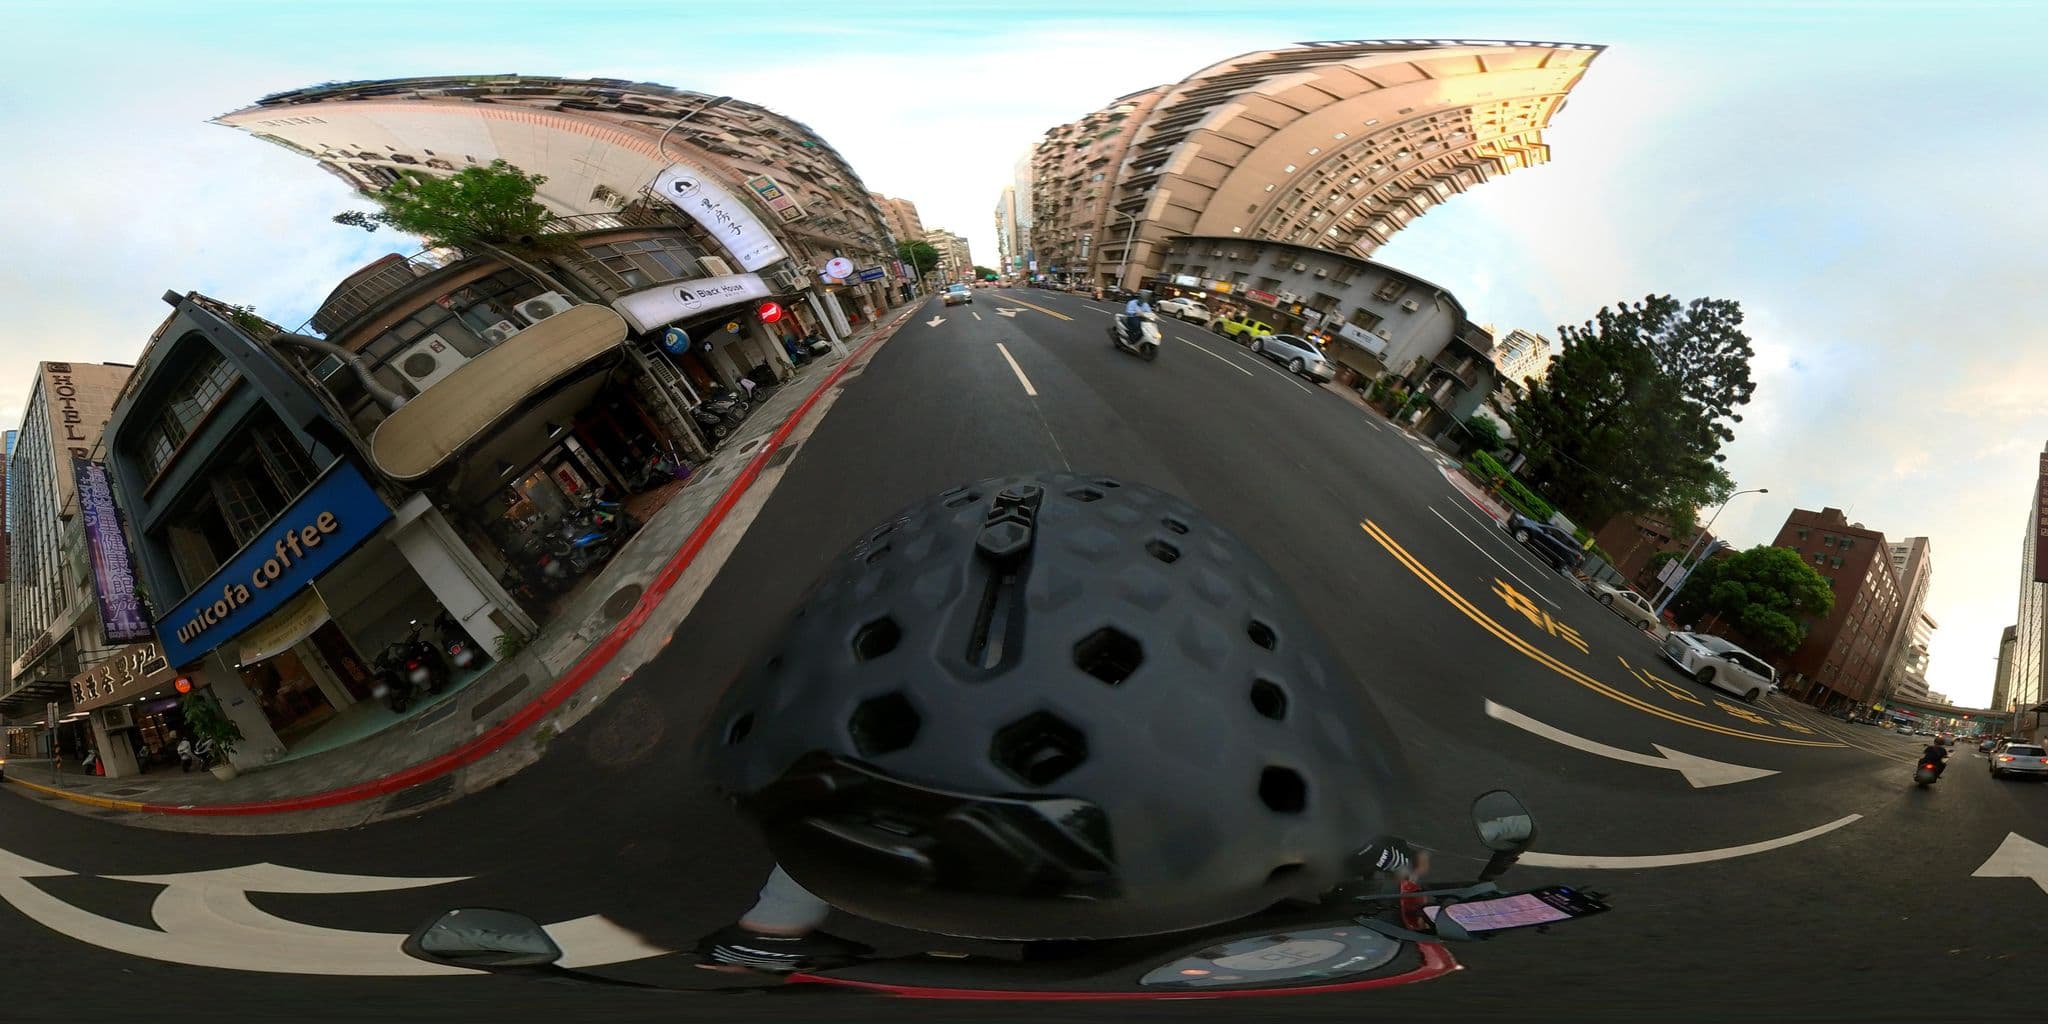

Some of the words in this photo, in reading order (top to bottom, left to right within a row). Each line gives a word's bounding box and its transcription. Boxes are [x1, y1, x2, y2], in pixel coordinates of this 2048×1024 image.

[701, 196, 744, 237] 黑房子
[697, 285, 720, 299] Black
[721, 283, 744, 294] House
[52, 375, 86, 440] HOTEL
[176, 583, 251, 644] unicofa
[252, 511, 338, 589] coffee
